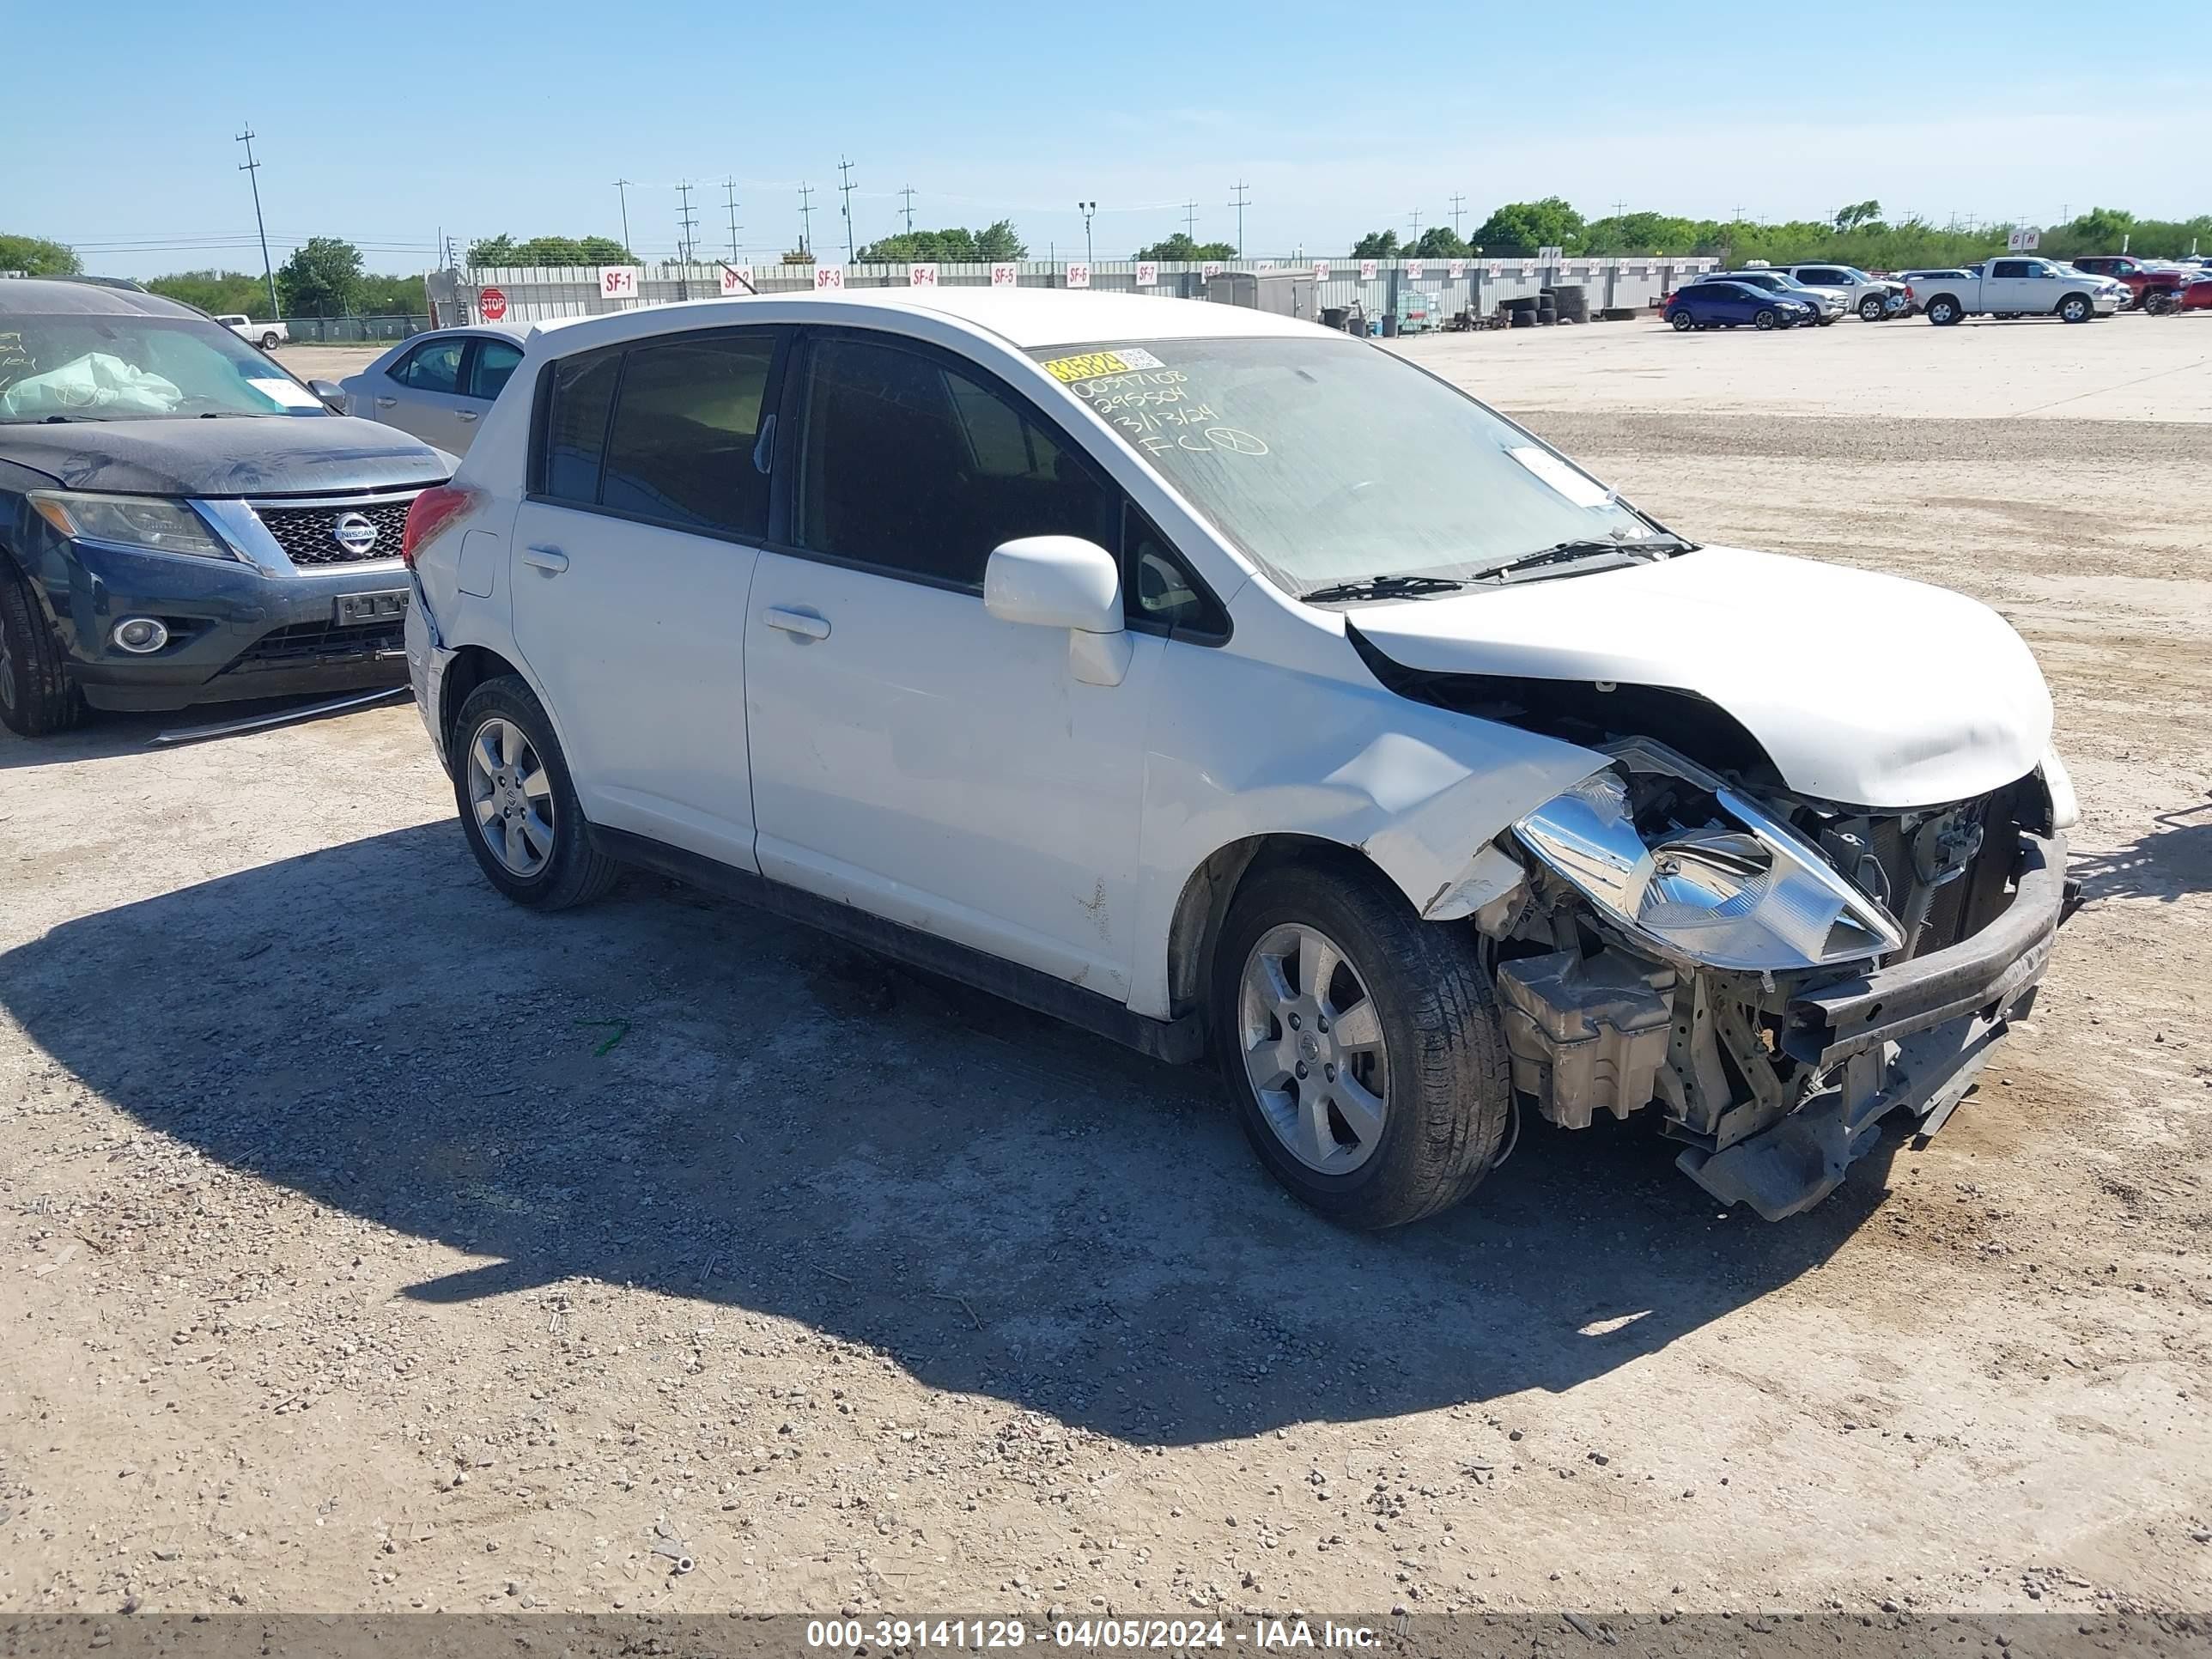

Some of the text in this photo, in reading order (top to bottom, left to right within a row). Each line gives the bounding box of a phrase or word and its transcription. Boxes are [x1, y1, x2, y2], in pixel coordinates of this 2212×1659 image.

[2012, 234, 2020, 245] G
[2027, 234, 2035, 244] H
[817, 270, 841, 288] SF-3
[913, 269, 934, 285] SF-4
[994, 268, 1014, 283] SF-5
[1070, 267, 1087, 283] SF-6
[1139, 266, 1155, 281] SF-7
[606, 273, 631, 292] SF-1
[481, 298, 505, 311] STOP
[1045, 353, 1128, 381] 335829
[1070, 370, 1188, 398] 00397108
[1093, 386, 1188, 414] 295504
[1114, 404, 1220, 432] 3/13/24
[341, 529, 375, 538] NISSAN
